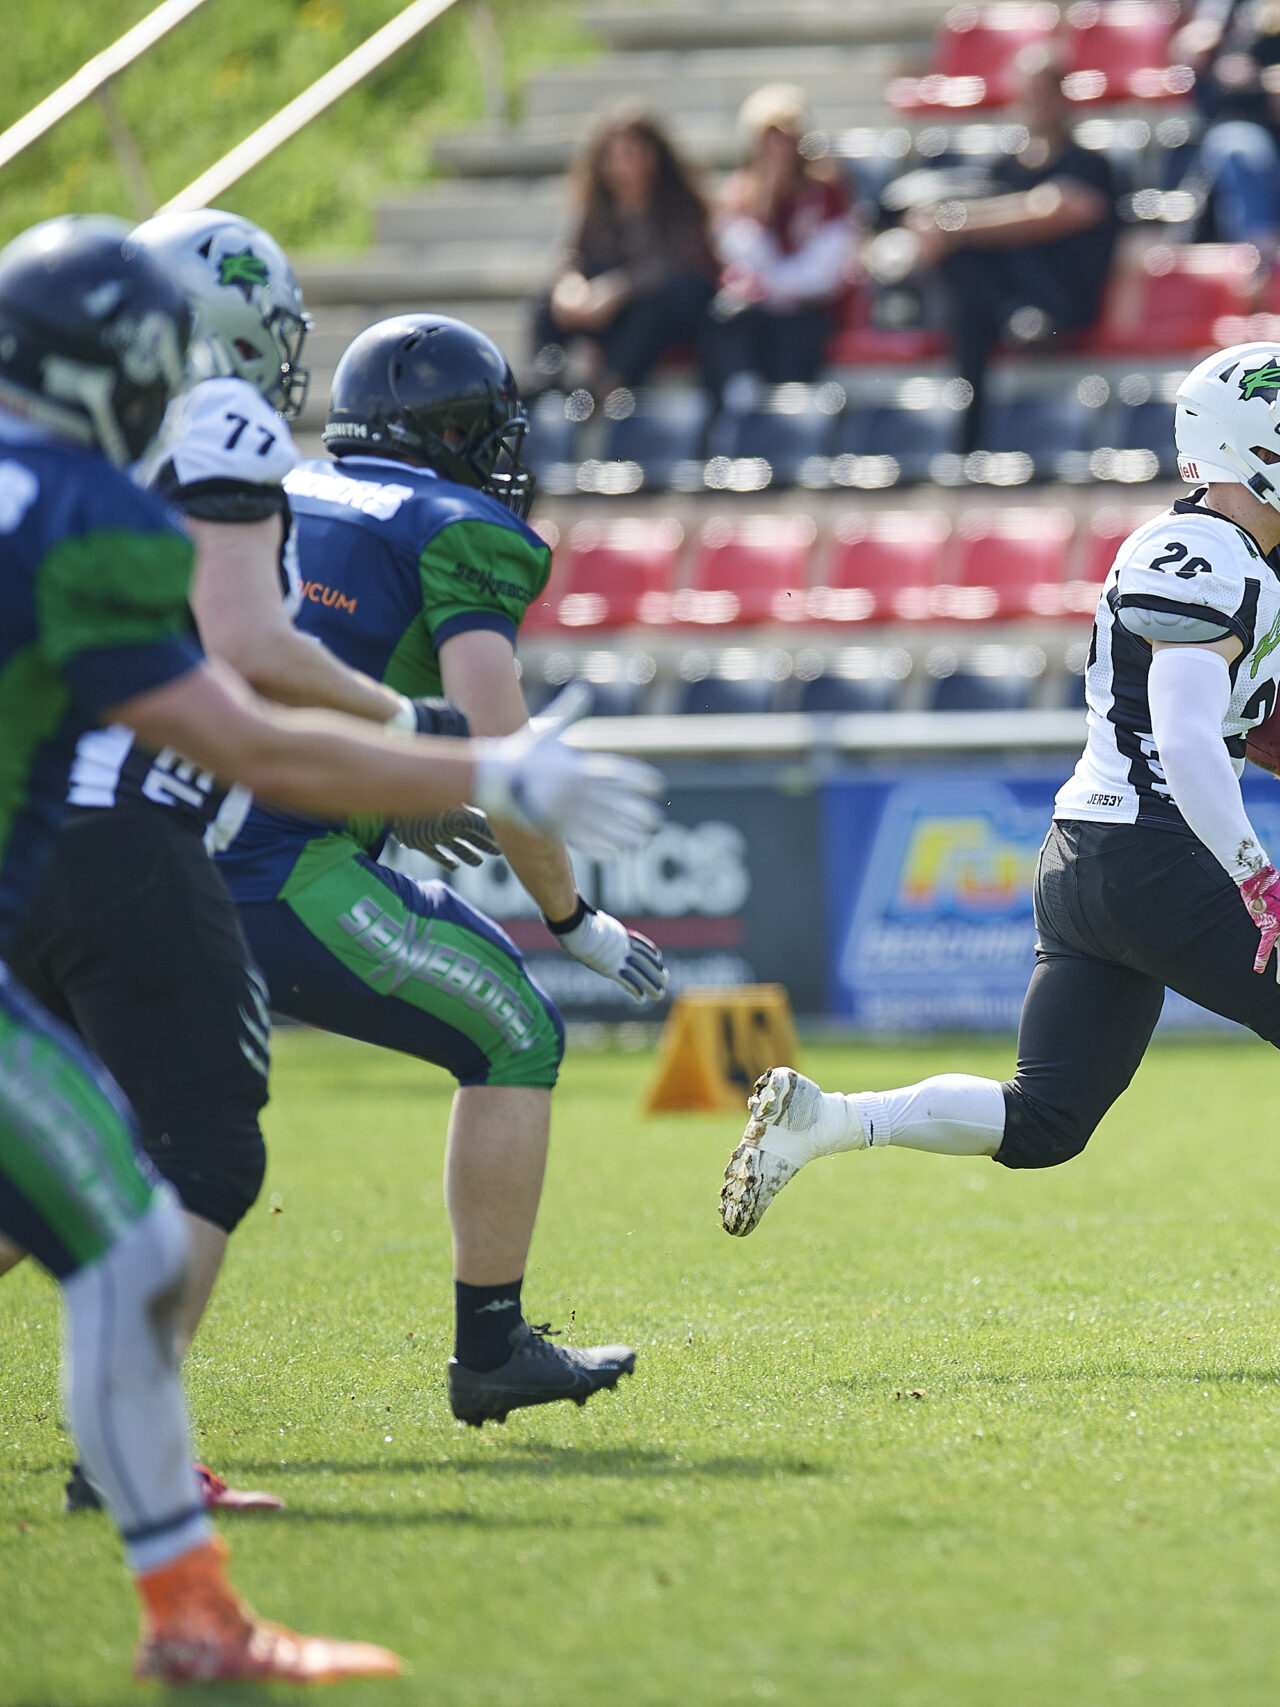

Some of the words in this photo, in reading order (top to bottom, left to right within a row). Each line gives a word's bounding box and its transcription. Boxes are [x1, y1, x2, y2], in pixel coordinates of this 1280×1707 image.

[225, 411, 276, 457] 77
[300, 578, 358, 615] ICUM
[1086, 793, 1128, 809] JER53Y
